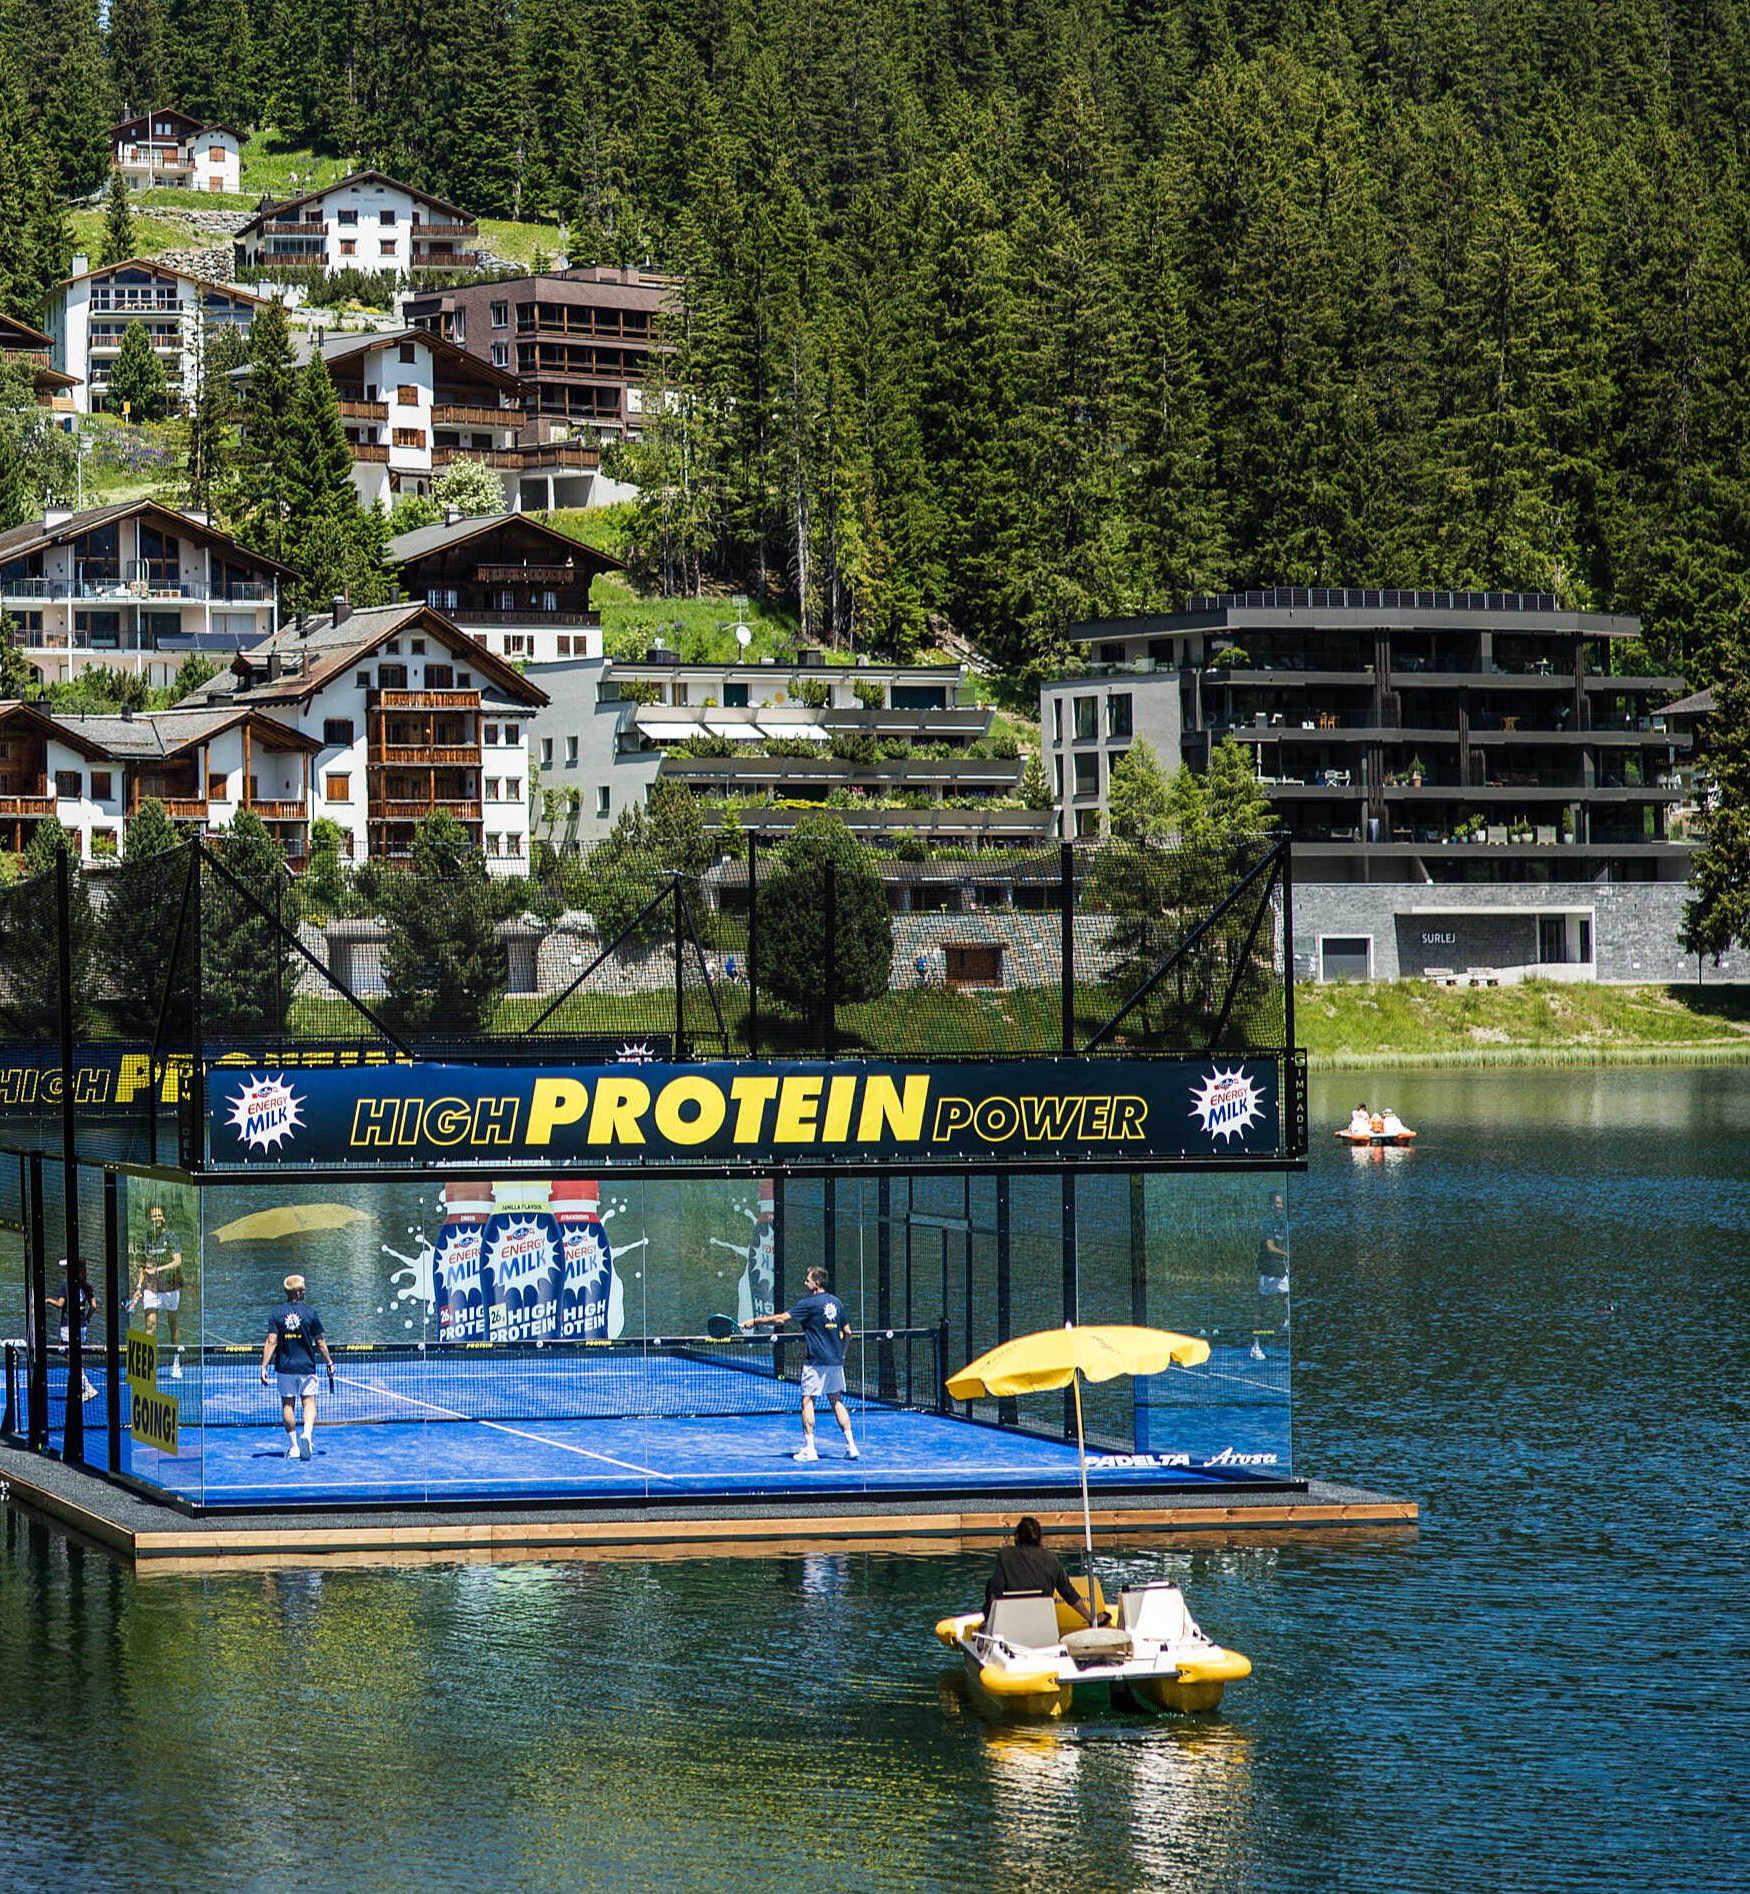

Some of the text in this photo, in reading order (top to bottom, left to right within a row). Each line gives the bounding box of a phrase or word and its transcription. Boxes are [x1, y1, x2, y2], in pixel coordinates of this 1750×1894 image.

[1421, 932, 1456, 944] SURLEJ
[247, 1095, 288, 1115] ENERGY
[1210, 1087, 1248, 1106] ENERGY
[350, 1074, 1148, 1146] HIGH PROTEIN POWER
[1207, 1097, 1248, 1129] MILK
[245, 1106, 288, 1138] MILK
[449, 1247, 481, 1264] ENER
[501, 1237, 545, 1258] ENERGY
[565, 1244, 597, 1261] NERGY
[446, 1259, 481, 1287] MIL
[498, 1249, 546, 1285] MILK
[454, 1304, 485, 1324] HIG
[507, 1299, 558, 1325] HIGH
[563, 1299, 606, 1322] HIGH
[439, 1318, 485, 1342] PROTE
[489, 1315, 556, 1342] PROTEIN
[128, 1339, 154, 1380] KEEP
[133, 1394, 176, 1445] GOING!
[1084, 1454, 1190, 1467] PADELTA
[1203, 1446, 1278, 1467] Arosa
